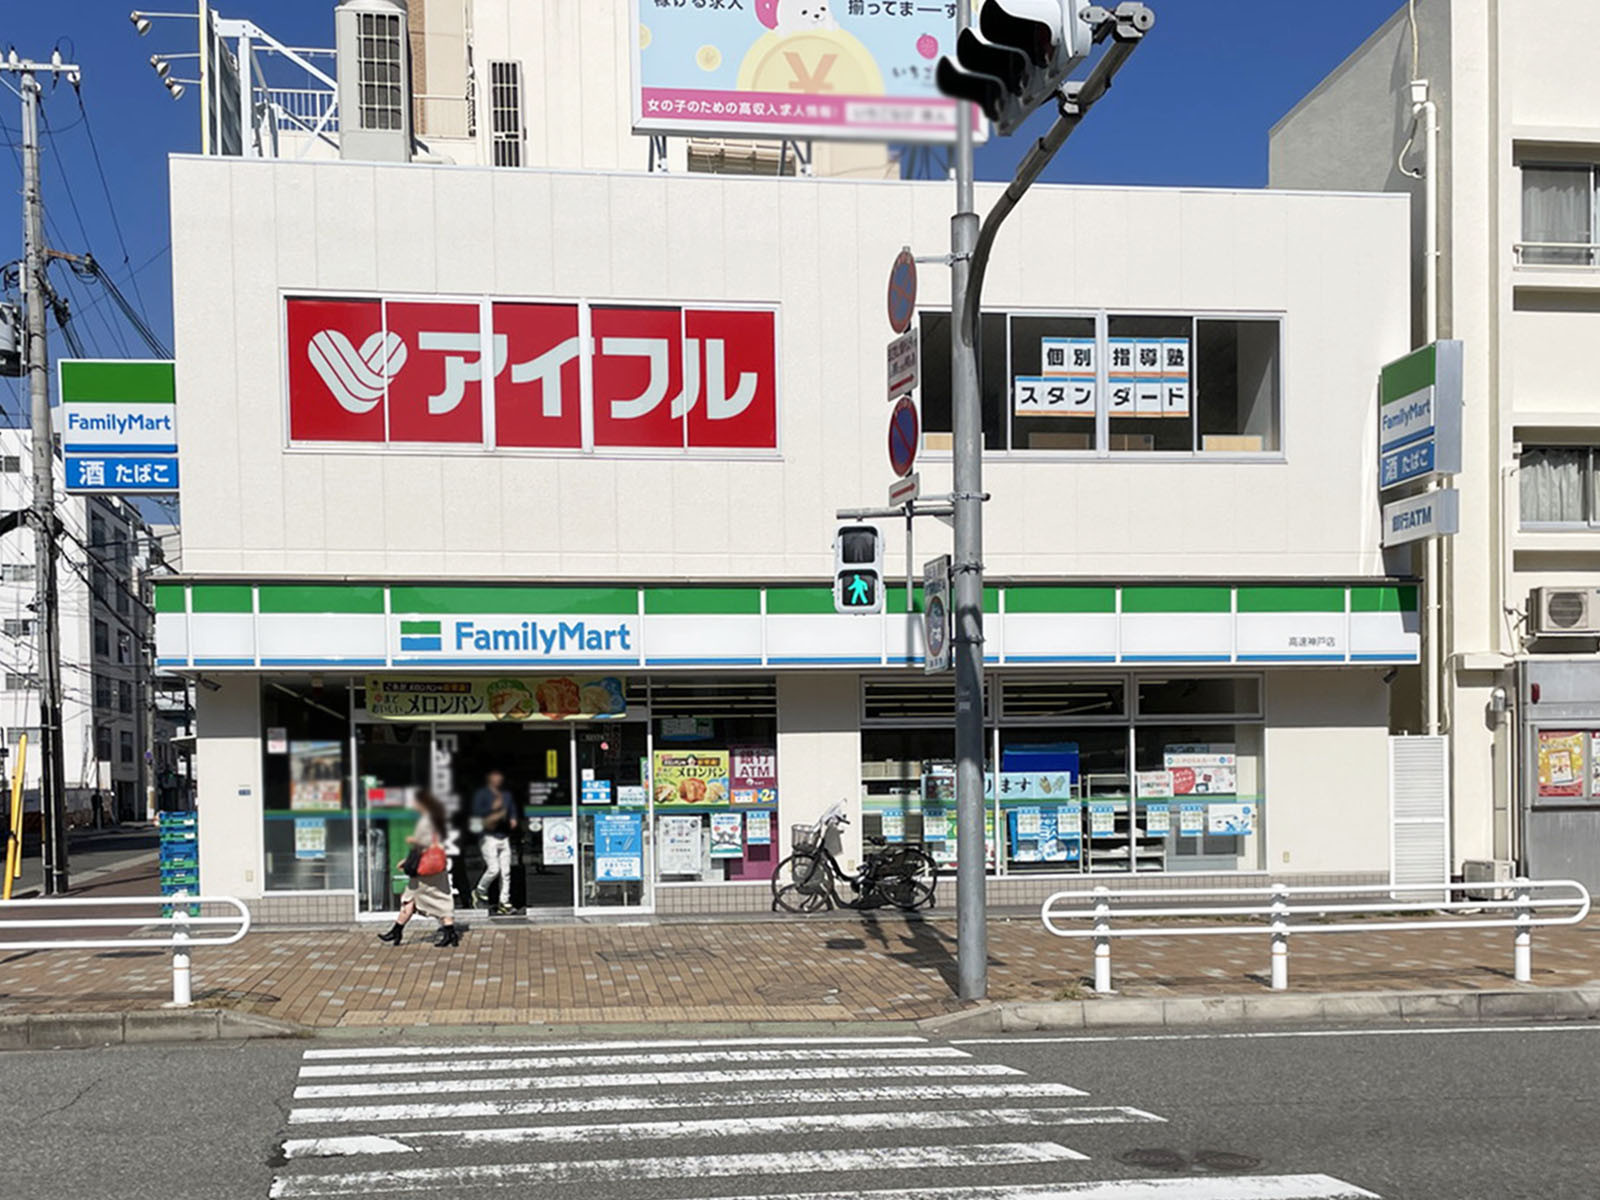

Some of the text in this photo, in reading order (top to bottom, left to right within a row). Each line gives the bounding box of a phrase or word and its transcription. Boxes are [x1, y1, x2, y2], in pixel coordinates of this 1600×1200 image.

[1047, 347, 1185, 367] 個別指導塾
[418, 331, 758, 420] アイフル
[1020, 386, 1185, 405] スタンダード
[68, 413, 172, 434] FamilyMart
[1382, 398, 1431, 432] FamilyMart
[79, 461, 170, 485] 酒 たばこ
[455, 621, 631, 654] FamilyMart
[406, 694, 484, 714] メロンパン
[678, 766, 727, 778] メロンパン
[740, 766, 770, 777] ATM
